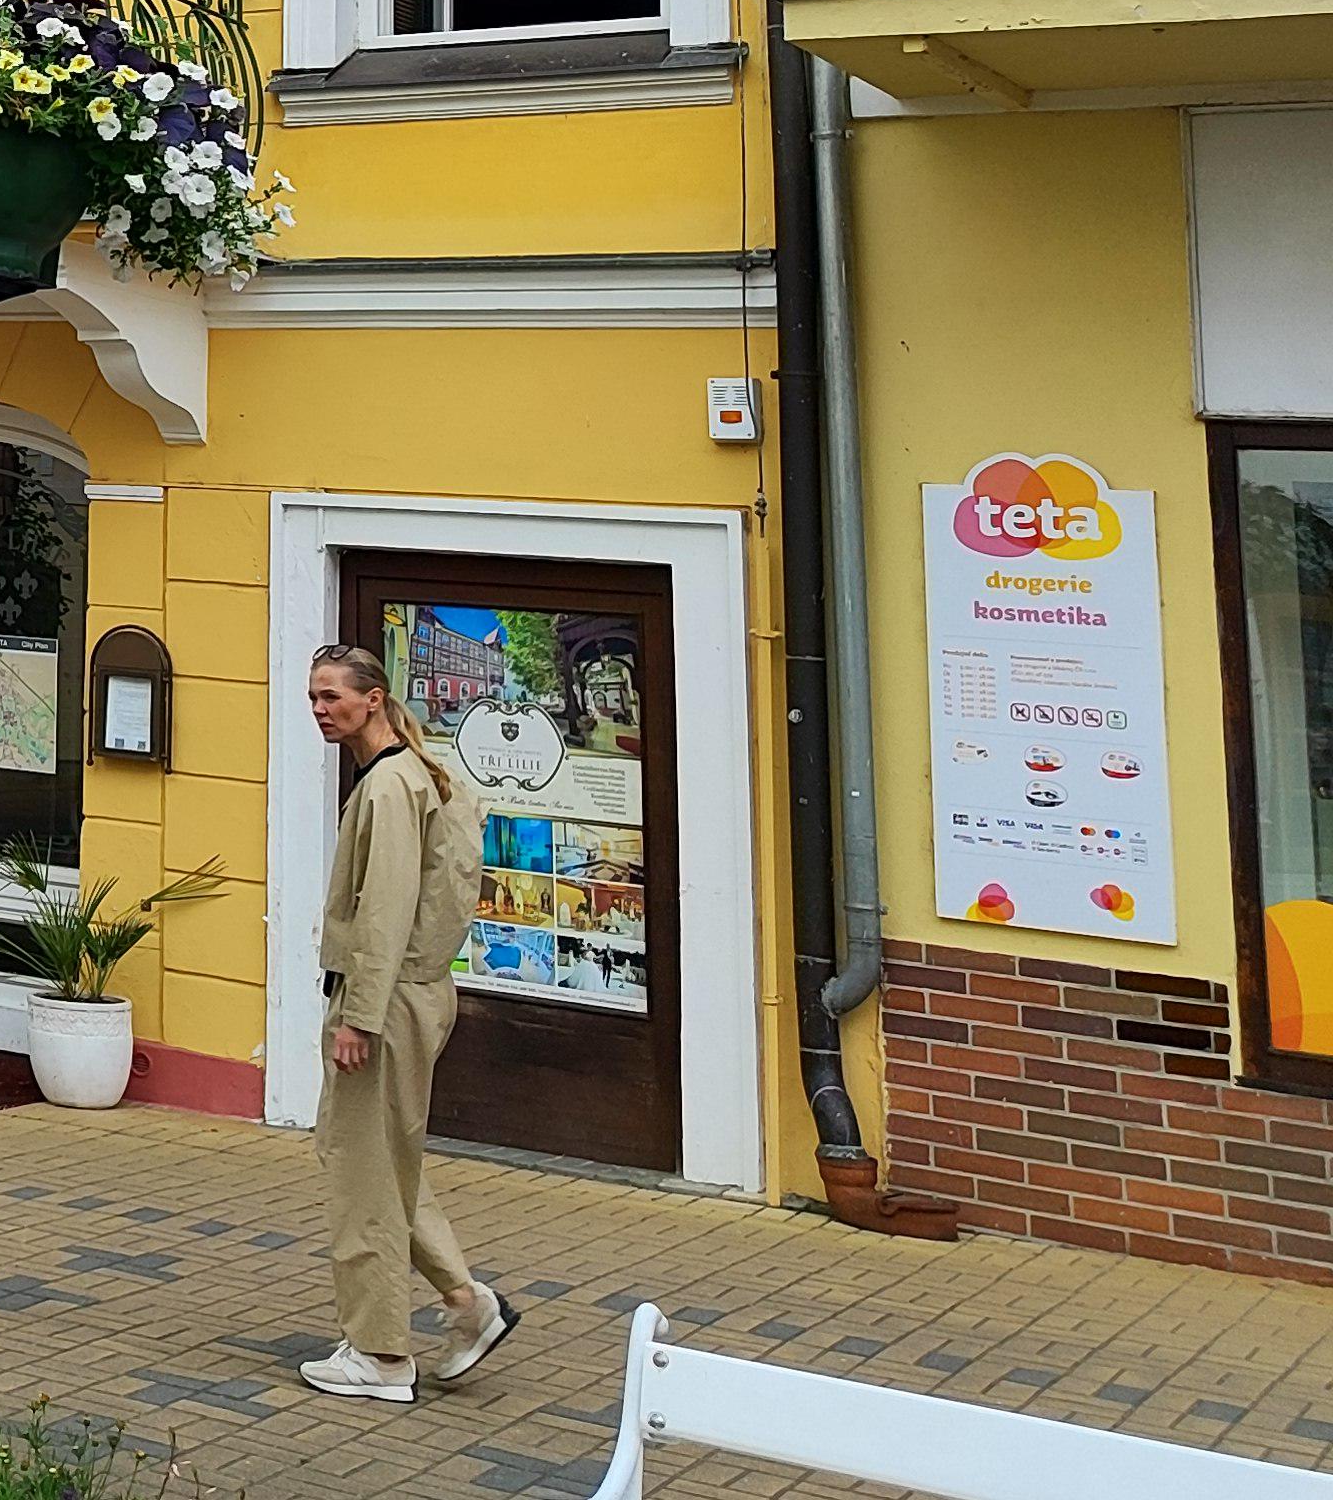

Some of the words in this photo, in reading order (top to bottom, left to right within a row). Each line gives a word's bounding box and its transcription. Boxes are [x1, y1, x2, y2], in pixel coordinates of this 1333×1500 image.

[974, 496, 1103, 541] teta
[985, 570, 1093, 596] drogerie
[973, 600, 1107, 627] kosmetika
[21, 640, 34, 650] City
